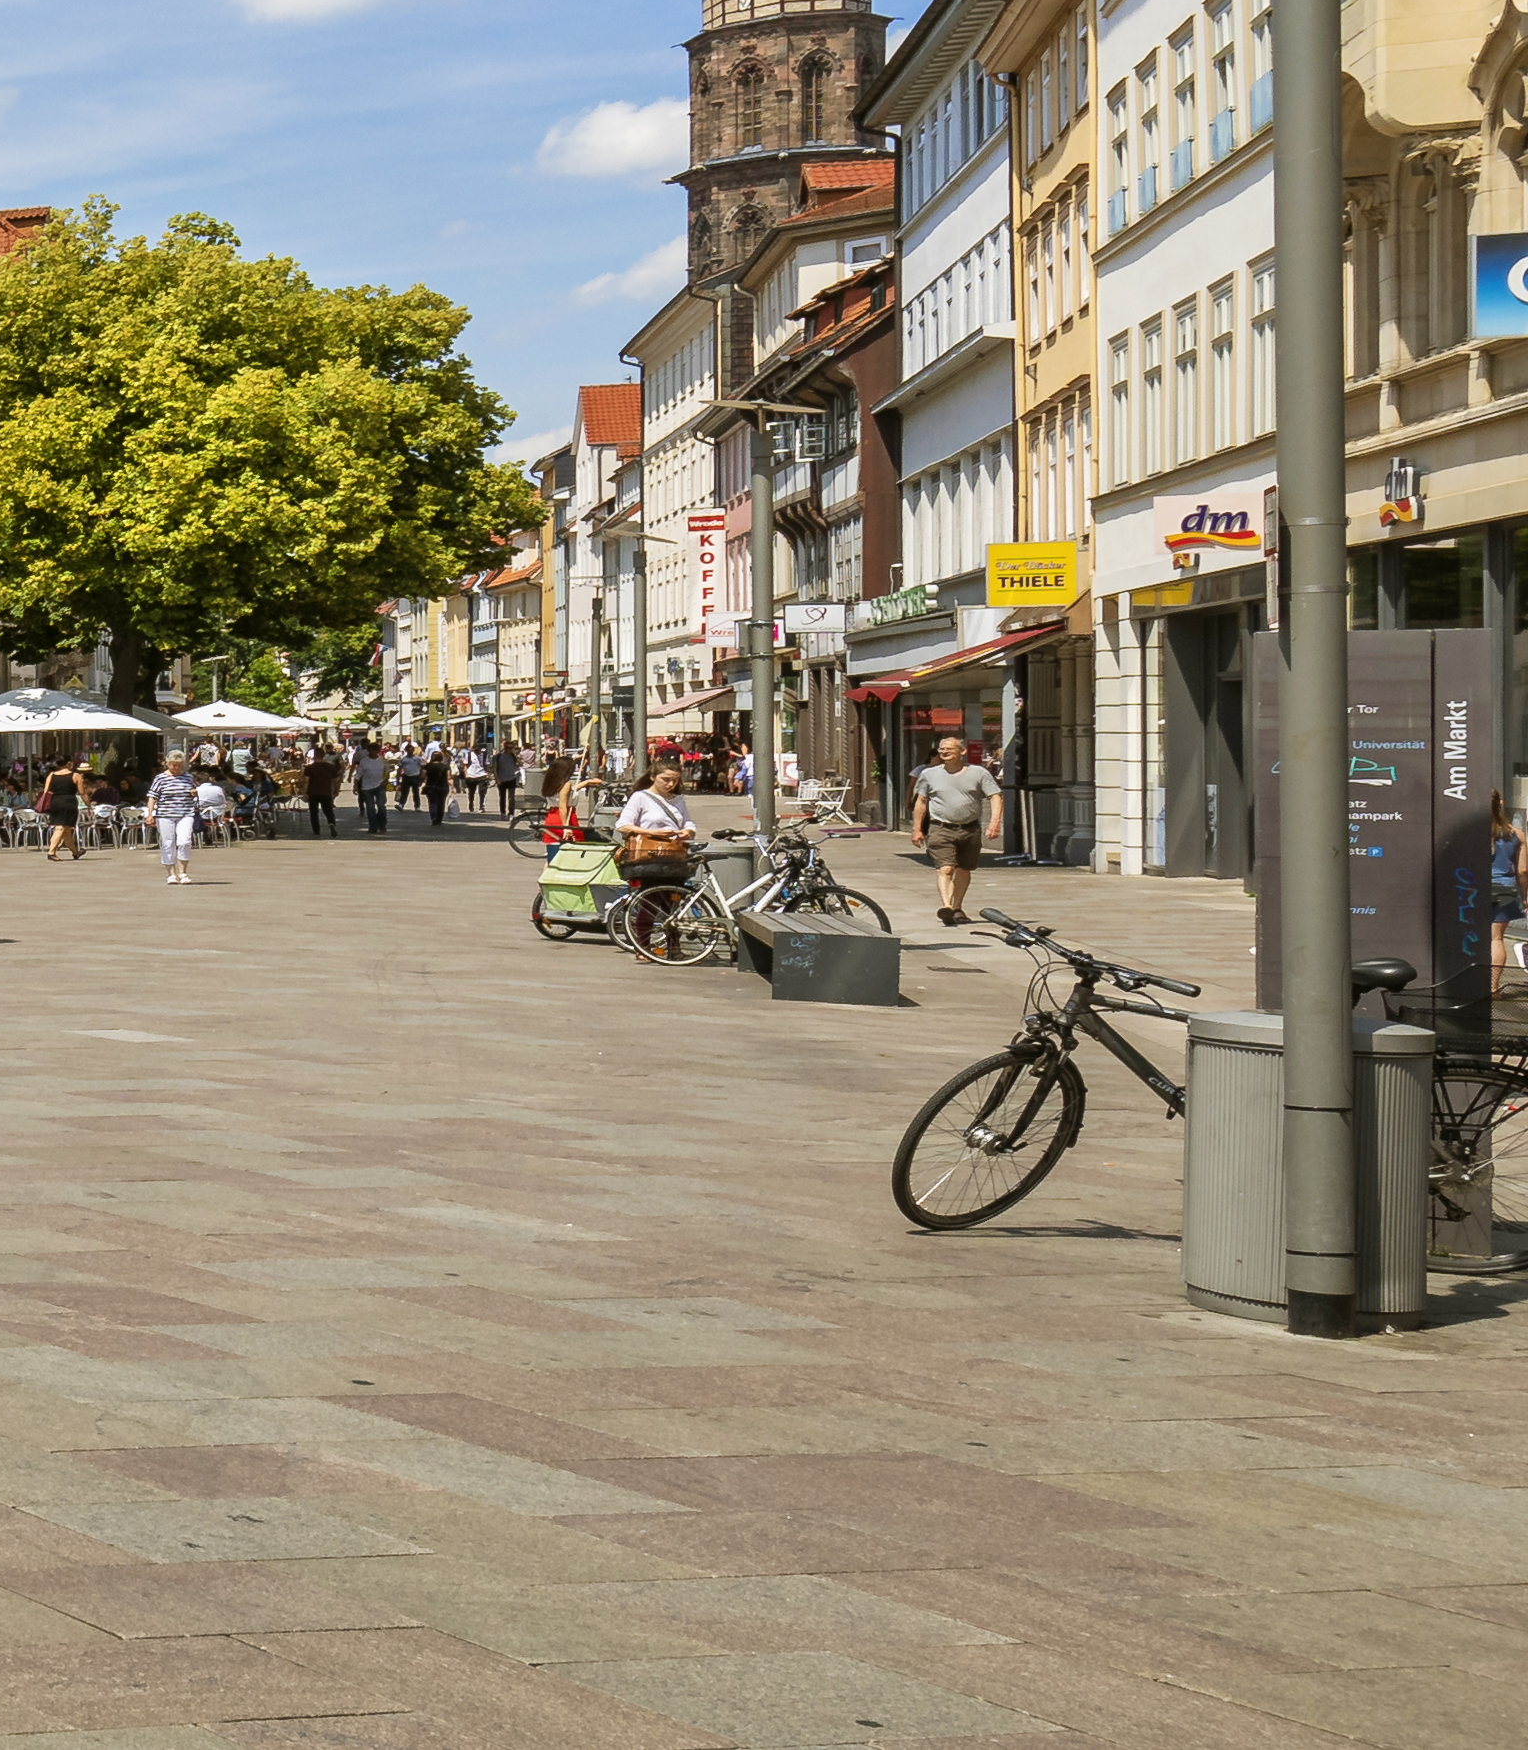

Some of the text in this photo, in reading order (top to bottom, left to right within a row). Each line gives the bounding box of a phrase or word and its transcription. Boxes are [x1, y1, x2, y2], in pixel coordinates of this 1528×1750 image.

[1181, 504, 1250, 534] dm
[997, 575, 1065, 588] THIELE
[1357, 704, 1380, 714] Tor
[1352, 740, 1426, 751] Universität
[1443, 700, 1467, 800] Am Markt
[1348, 812, 1403, 821] ampark
